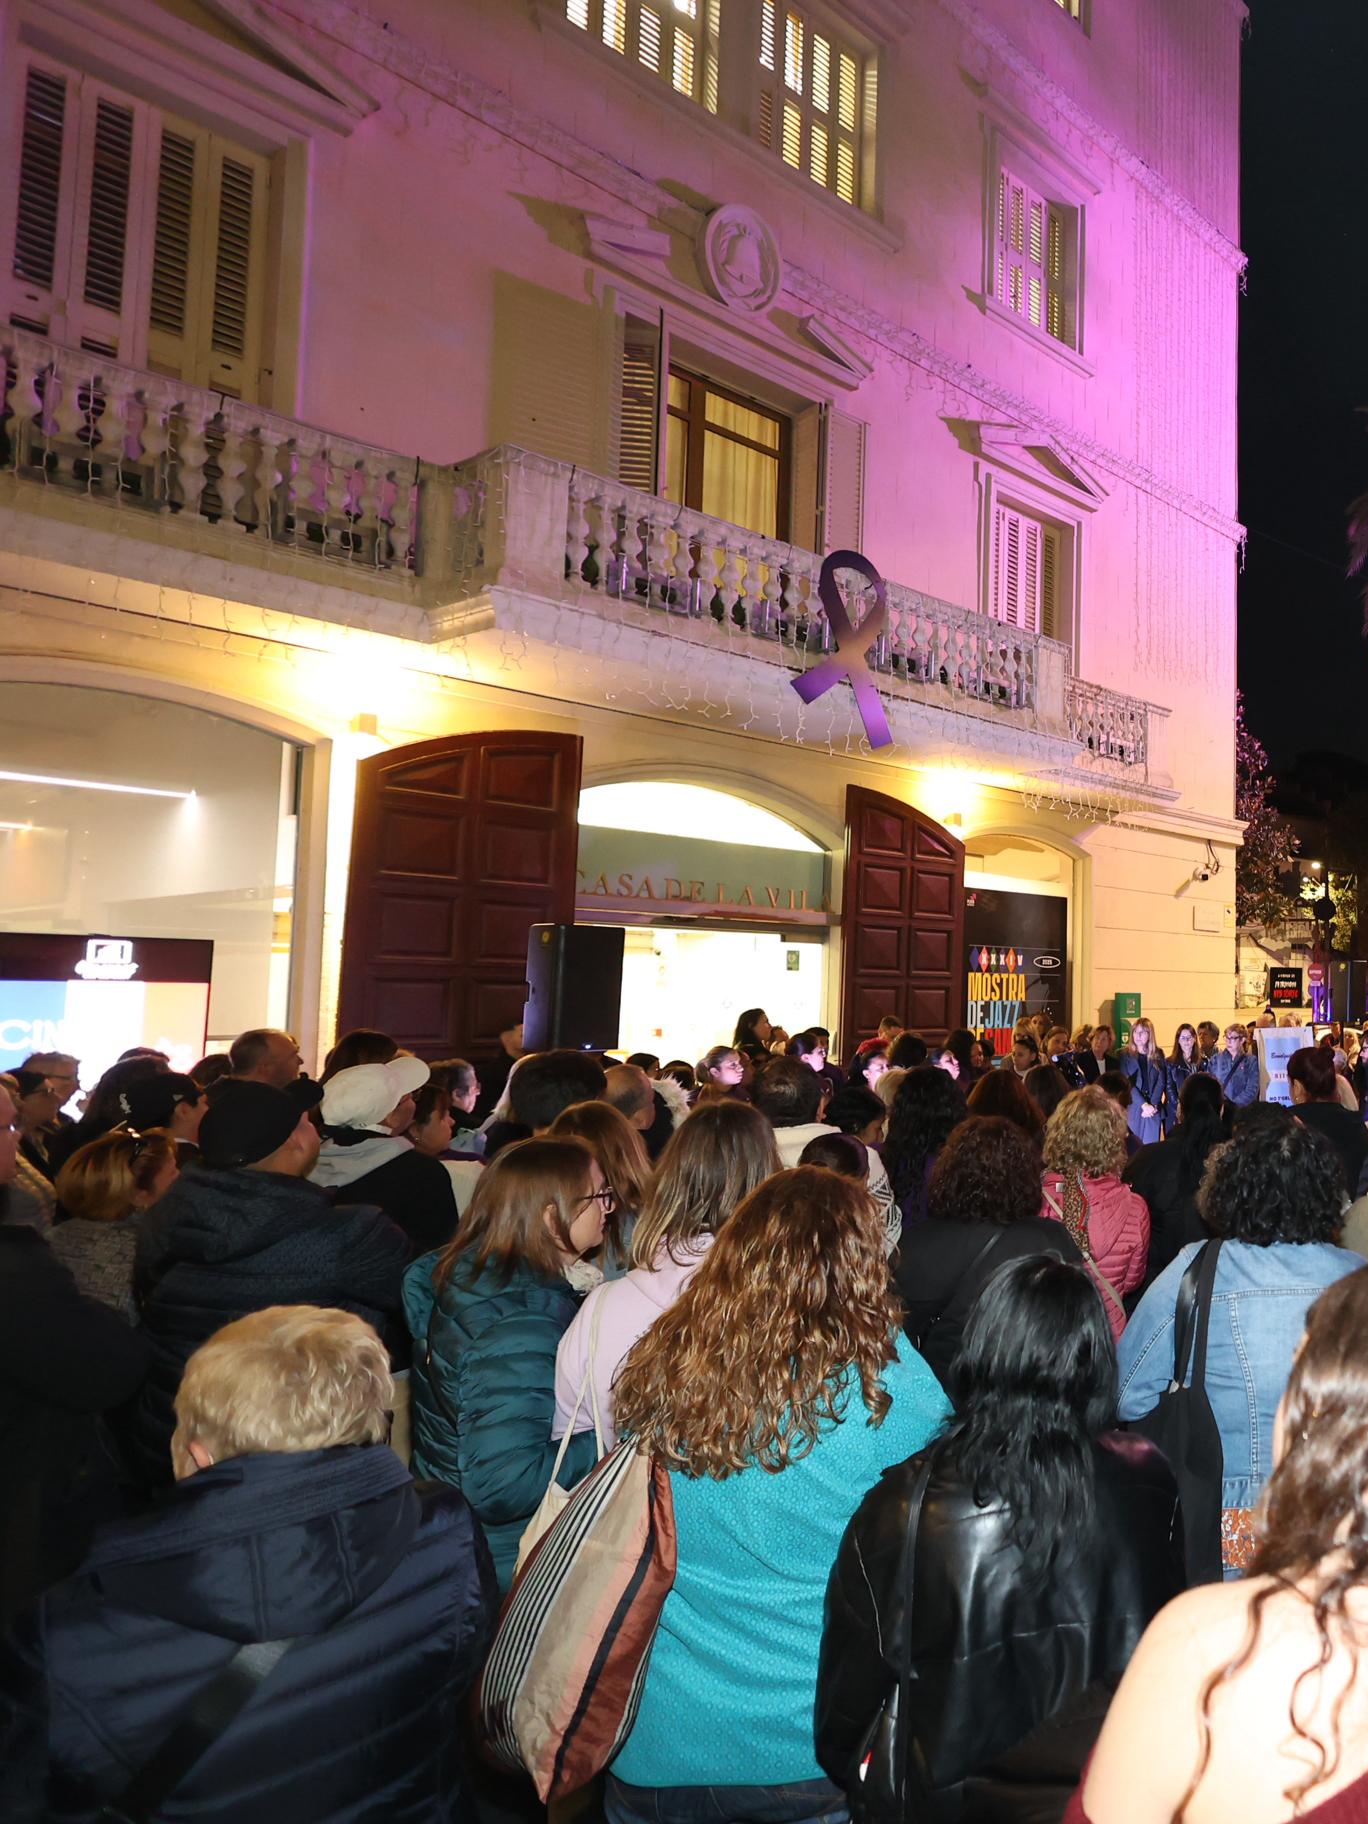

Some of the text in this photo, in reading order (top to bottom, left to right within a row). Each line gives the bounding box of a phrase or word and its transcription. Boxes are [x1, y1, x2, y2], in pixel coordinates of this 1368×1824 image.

[664, 877, 705, 903] DE
[716, 882, 757, 907] LA
[968, 972, 1026, 1001] MOSTRA
[967, 1000, 1021, 1028] DE JAZZ
